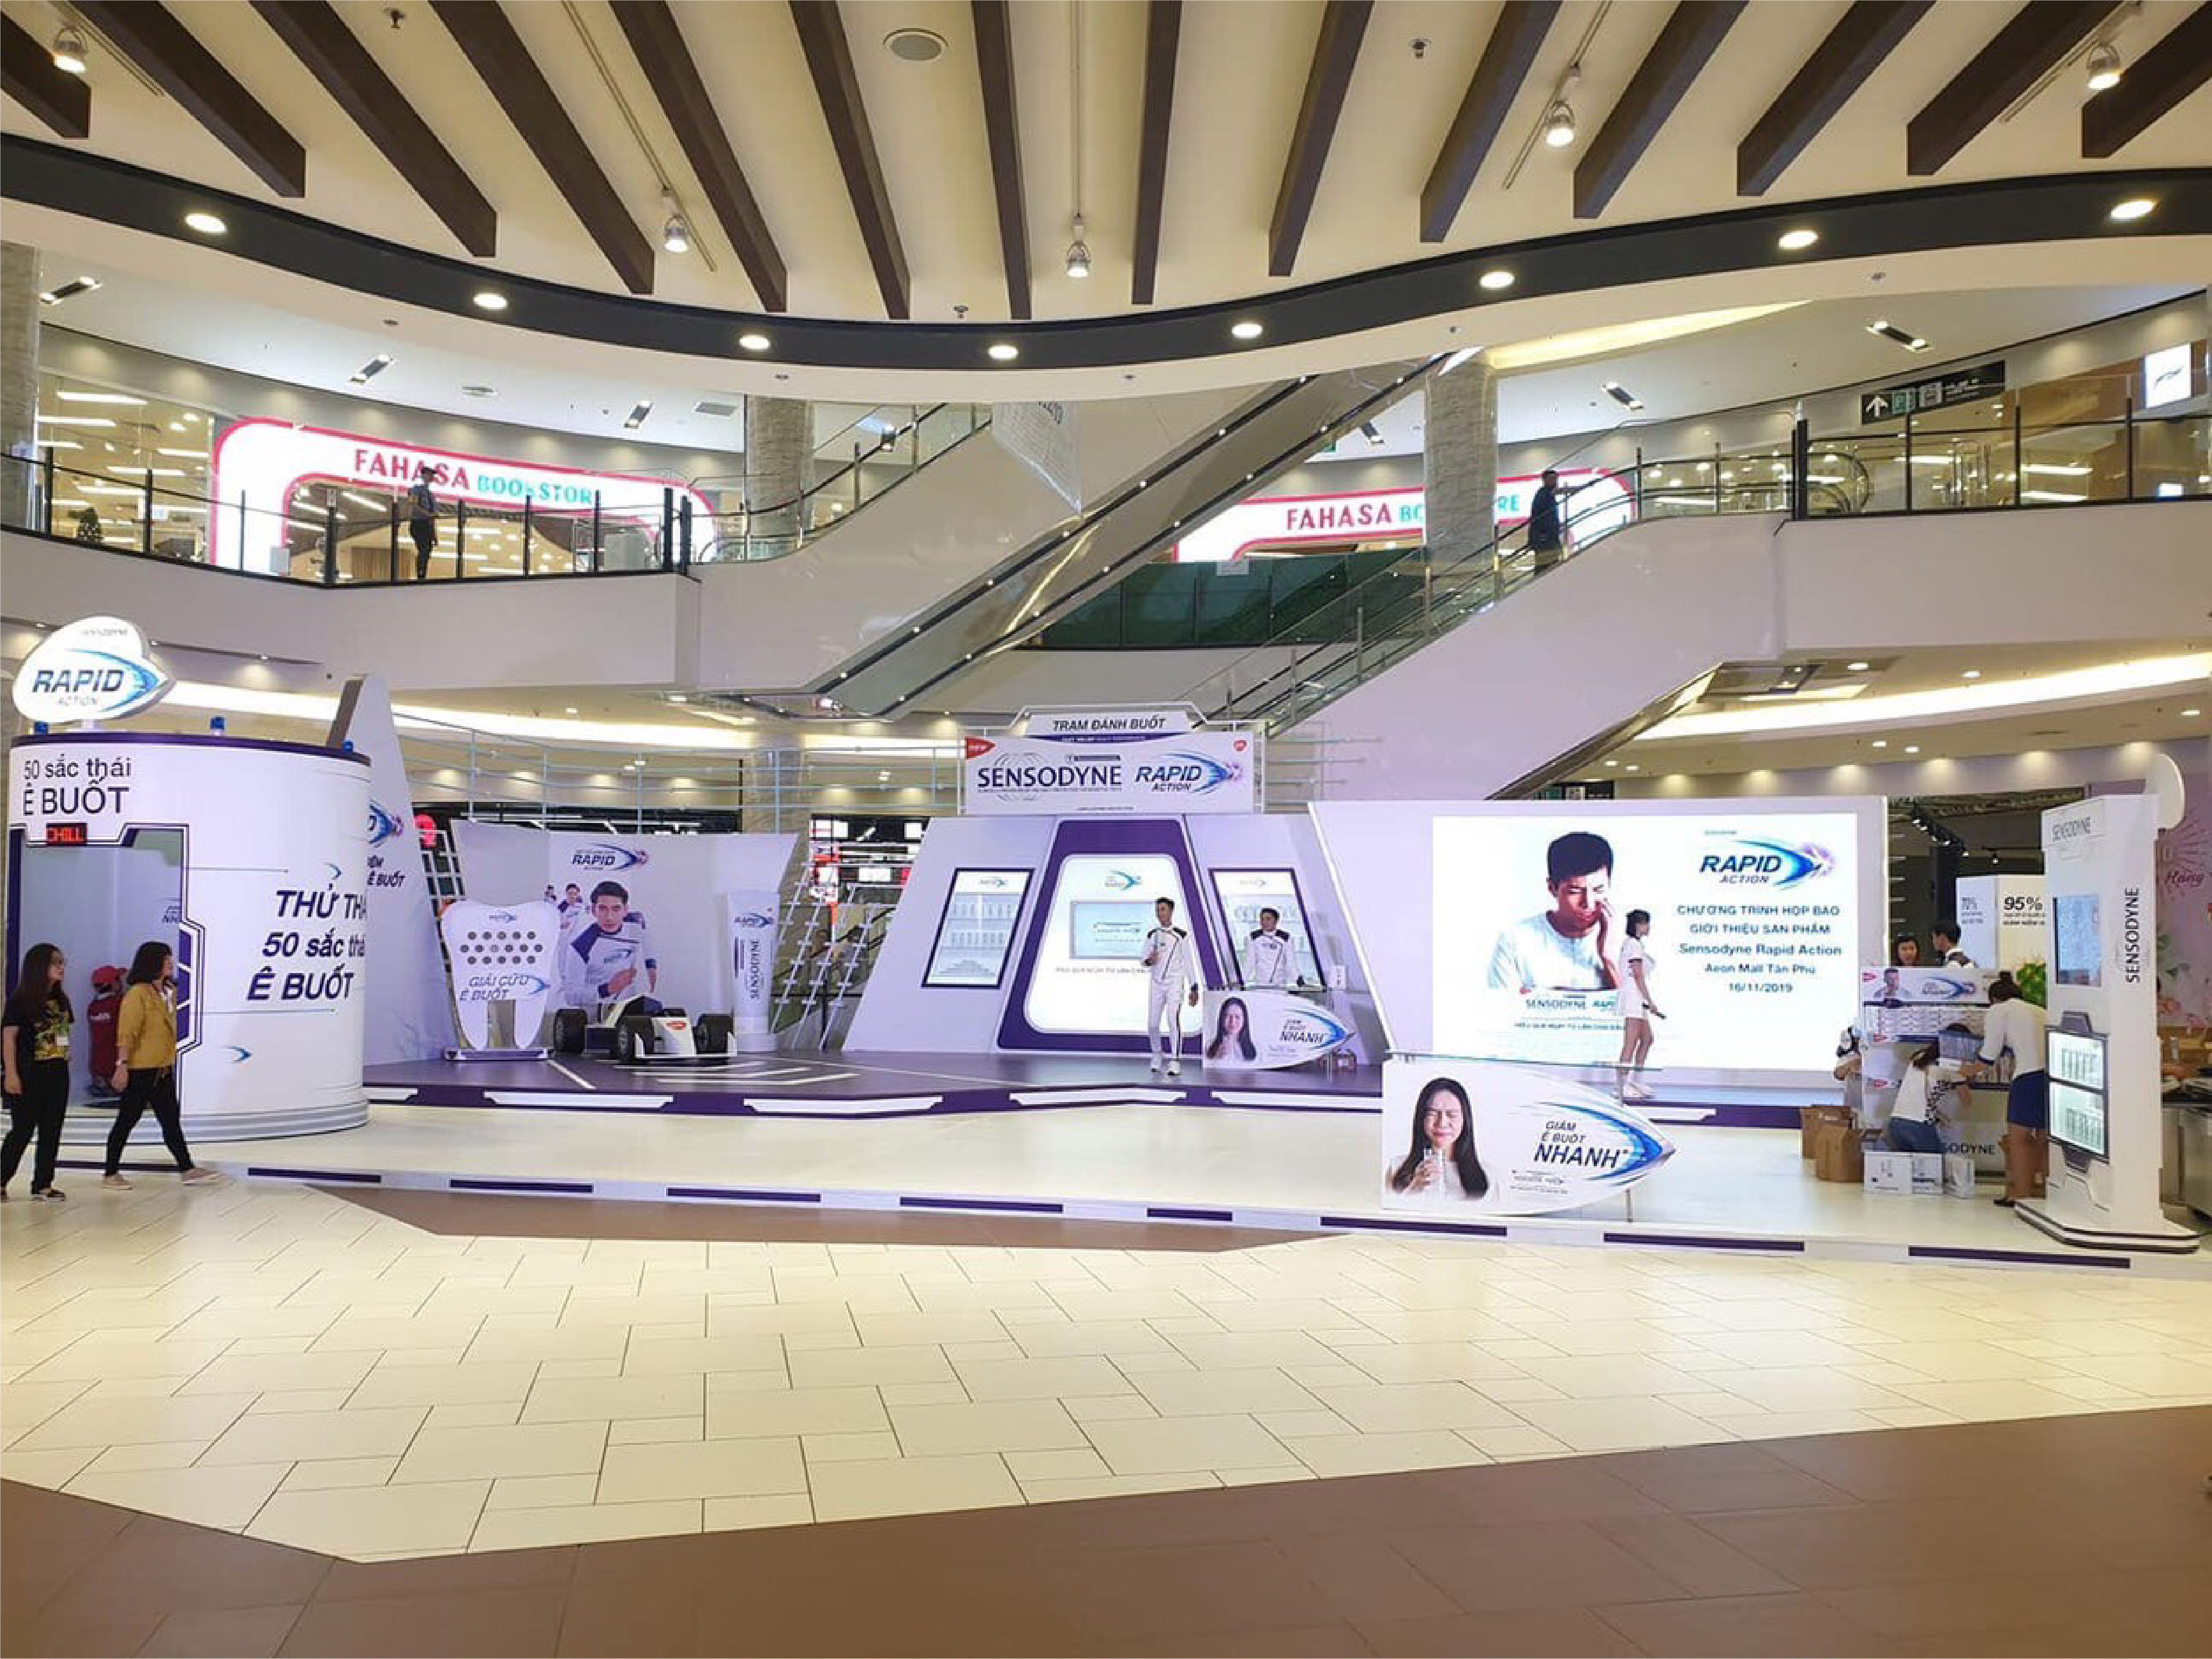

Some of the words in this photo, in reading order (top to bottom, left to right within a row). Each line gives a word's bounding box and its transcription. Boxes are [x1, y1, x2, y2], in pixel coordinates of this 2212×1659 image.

[354, 449, 470, 490] FAHASA
[1286, 503, 1392, 530] FAHASA
[32, 669, 125, 692] RAPID
[24, 759, 40, 779] 50
[86, 755, 132, 777] thái
[978, 766, 1122, 788] SENSODYNE
[1135, 765, 1202, 782] RAPID
[42, 777, 130, 815] BUỐT
[1152, 783, 1192, 792] ACTION
[572, 854, 616, 866] RAPID
[1699, 855, 1783, 873] RAPID
[1719, 874, 1770, 884] ACTION
[276, 883, 339, 918] THỬ
[2003, 896, 2043, 911] 95%
[262, 931, 299, 958] 50
[306, 927, 344, 958] sắc
[2124, 887, 2140, 984] SENSODYNE
[1679, 942, 1751, 956] Sensodyne
[1756, 943, 1794, 957] Rapid
[1799, 944, 1842, 955] Action
[1704, 963, 1736, 973] Aeon
[1738, 963, 1763, 973] Mall
[247, 965, 276, 1000] Ê
[281, 962, 354, 1000] BUỐT
[1729, 982, 1793, 993] 16/11/2019
[1525, 999, 1587, 1010] SENSODYNE
